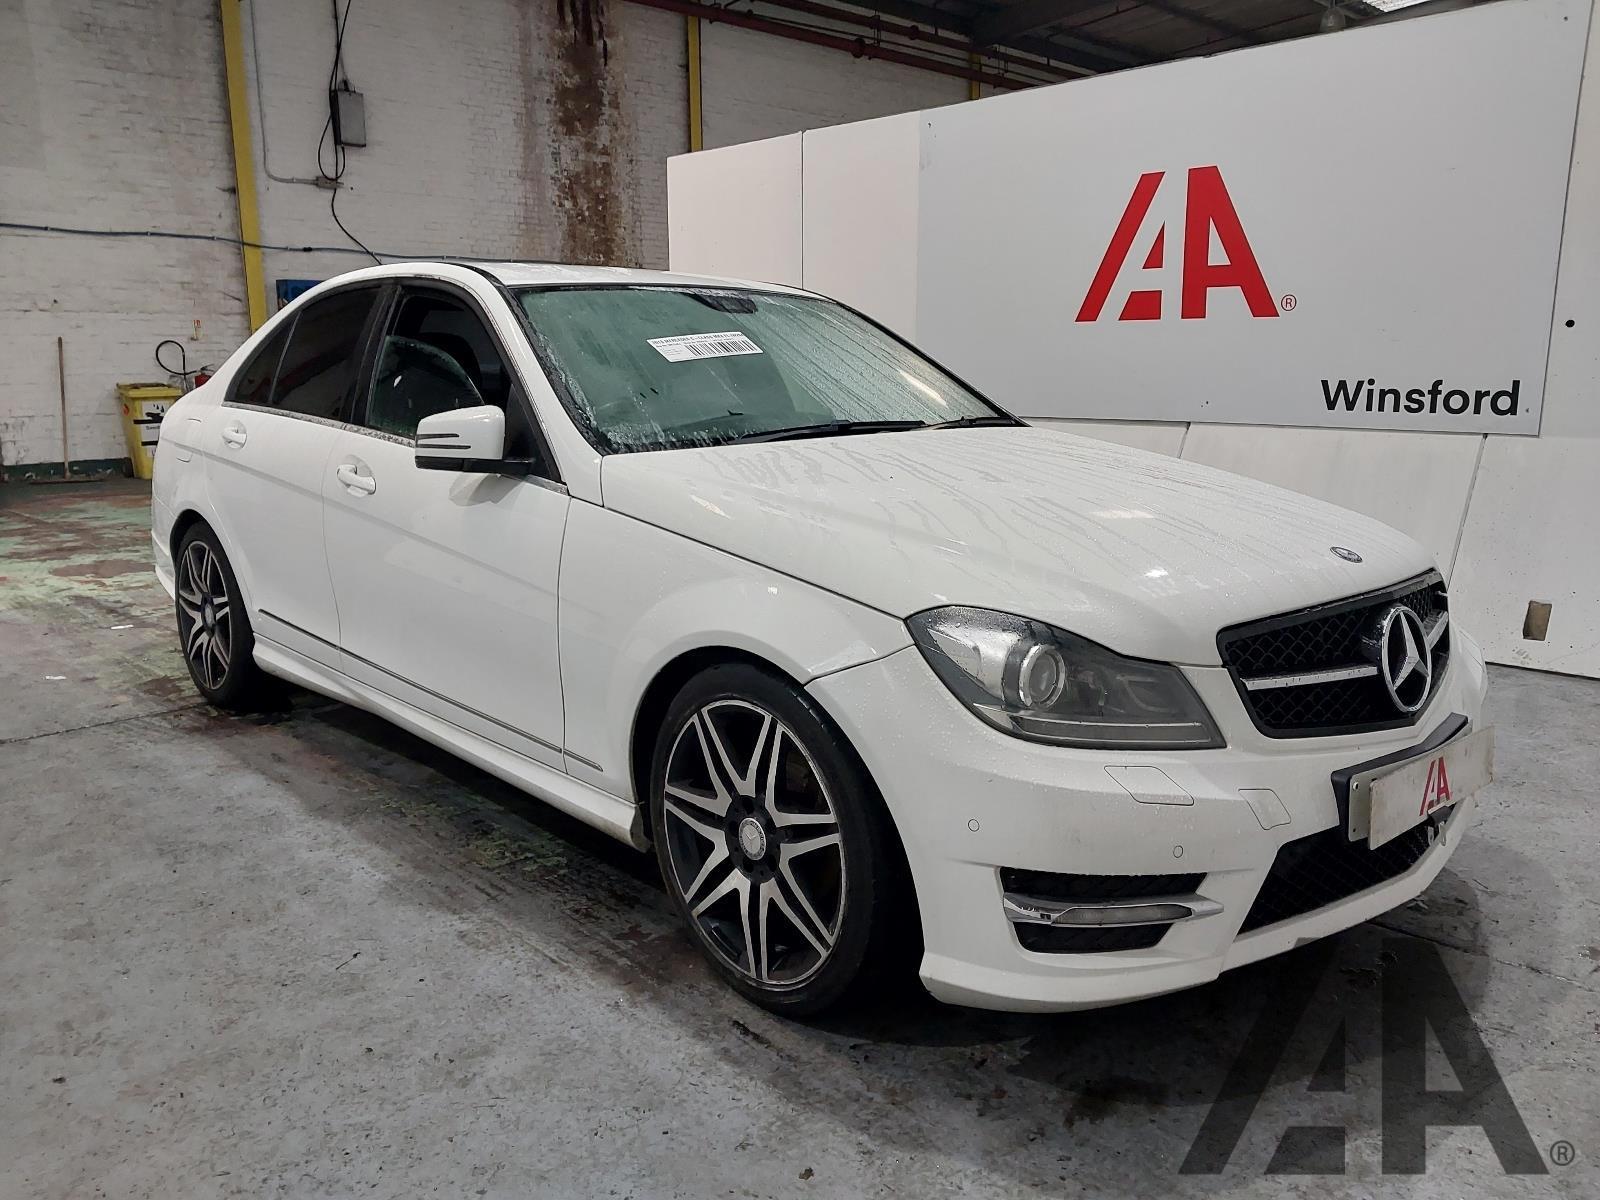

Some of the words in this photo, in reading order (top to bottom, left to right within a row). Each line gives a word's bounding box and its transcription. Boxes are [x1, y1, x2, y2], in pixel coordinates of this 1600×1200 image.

[1075, 165, 1280, 323] AA
[1320, 378, 1521, 416] Winsford
[1419, 756, 1452, 817] AA
